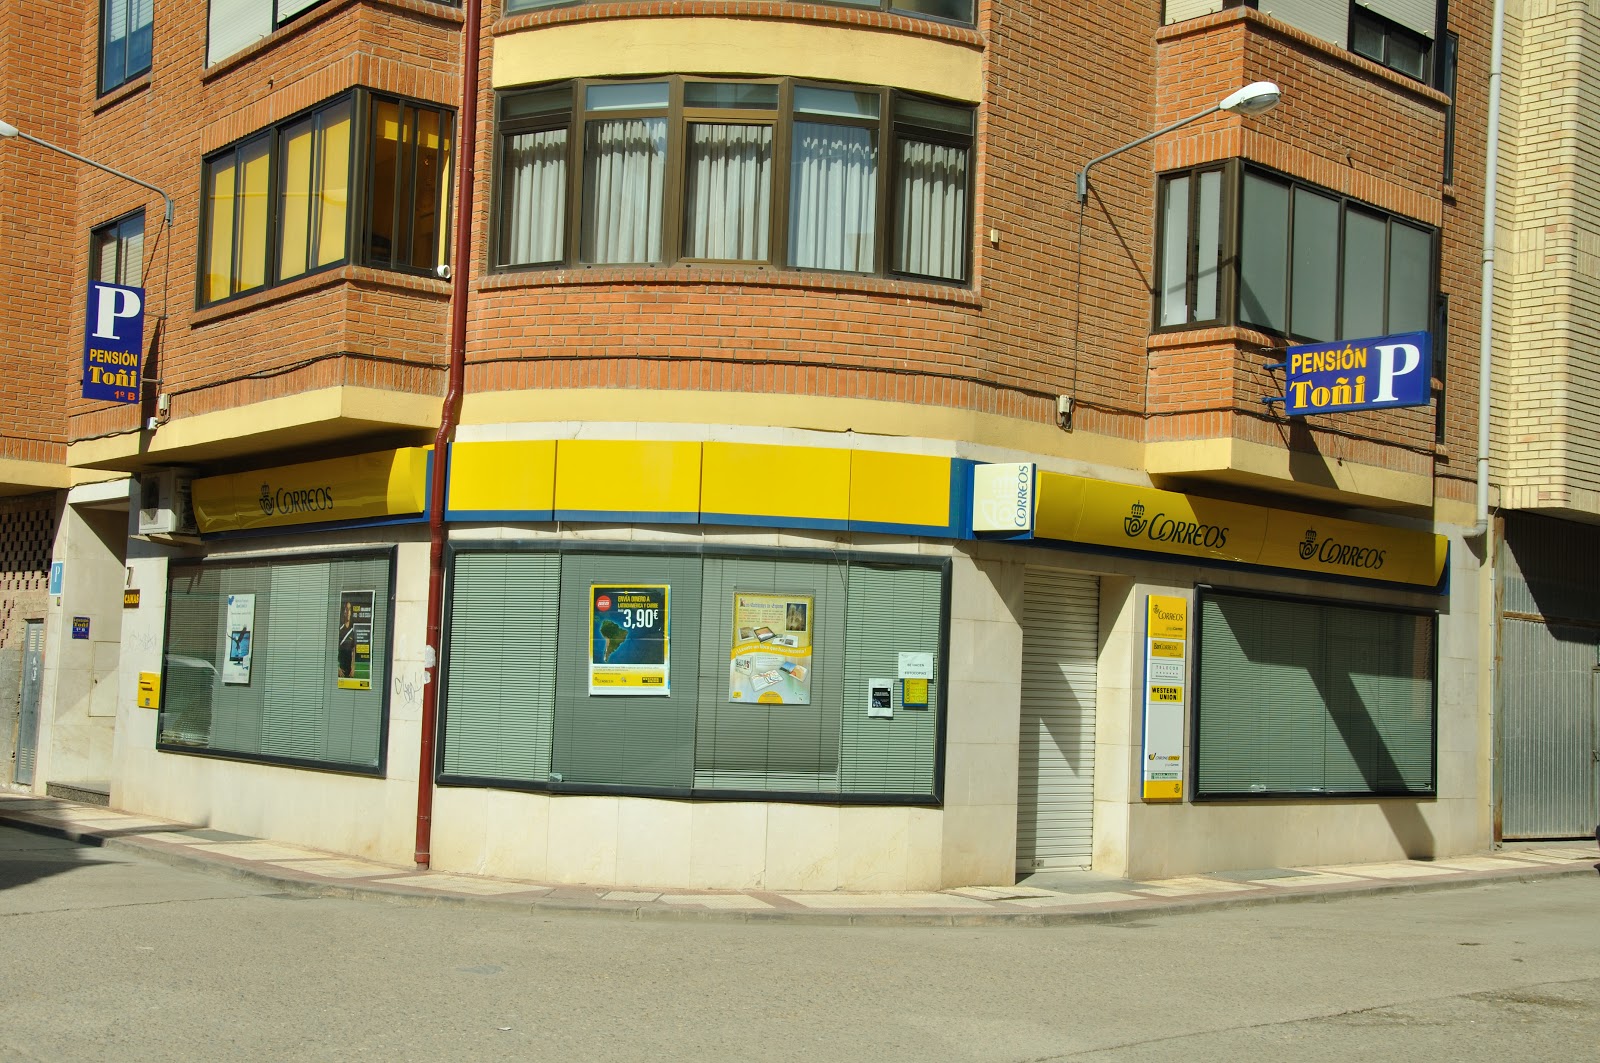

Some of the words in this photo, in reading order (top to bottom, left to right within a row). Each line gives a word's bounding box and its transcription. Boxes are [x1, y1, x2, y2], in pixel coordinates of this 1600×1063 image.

[92, 284, 141, 340] P
[89, 348, 138, 367] PENSIÓN
[1291, 343, 1368, 375] PENSIÓN
[1372, 343, 1420, 403] P
[88, 366, 138, 388] Toñi
[1289, 375, 1366, 409] Toñi
[127, 392, 136, 401] B
[275, 486, 334, 515] CORREOS
[1014, 465, 1029, 527] CORREOS
[1147, 512, 1230, 549] CORREOS
[1317, 537, 1387, 571] CORREOS
[54, 565, 61, 583] P
[1158, 610, 1184, 622] CORREOS
